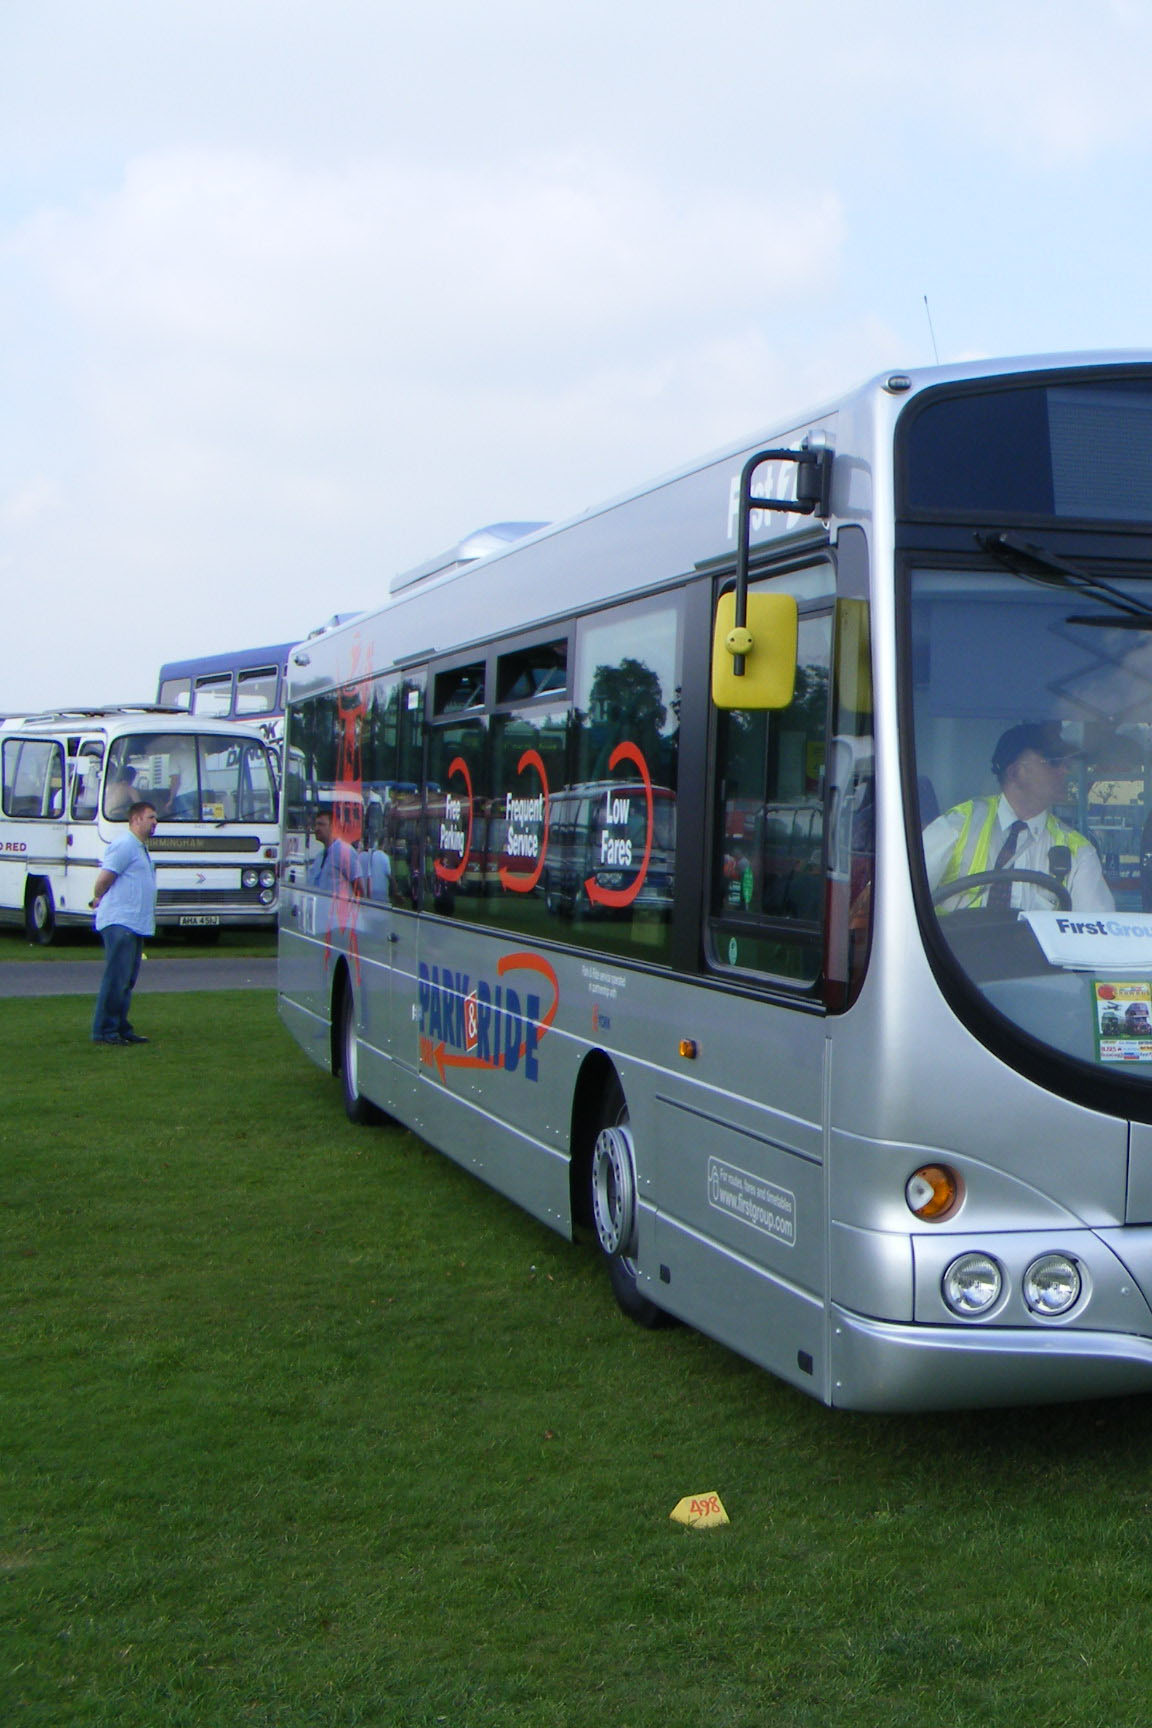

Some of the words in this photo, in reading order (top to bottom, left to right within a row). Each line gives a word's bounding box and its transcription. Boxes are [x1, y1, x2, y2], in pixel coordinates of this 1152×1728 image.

[445, 793, 461, 820] Free
[505, 792, 543, 828] Frequent
[606, 790, 631, 825] Low
[5, 842, 27, 852] RED
[147, 837, 205, 849] IRMINGHAM
[439, 823, 465, 858] Parking
[507, 825, 539, 858] Service
[600, 830, 632, 866] Fares
[418, 961, 470, 1050] PARK
[477, 979, 541, 1083] RIDE
[719, 1188, 793, 1237] www.firstgroup.com
[690, 1495, 721, 1516] 498
